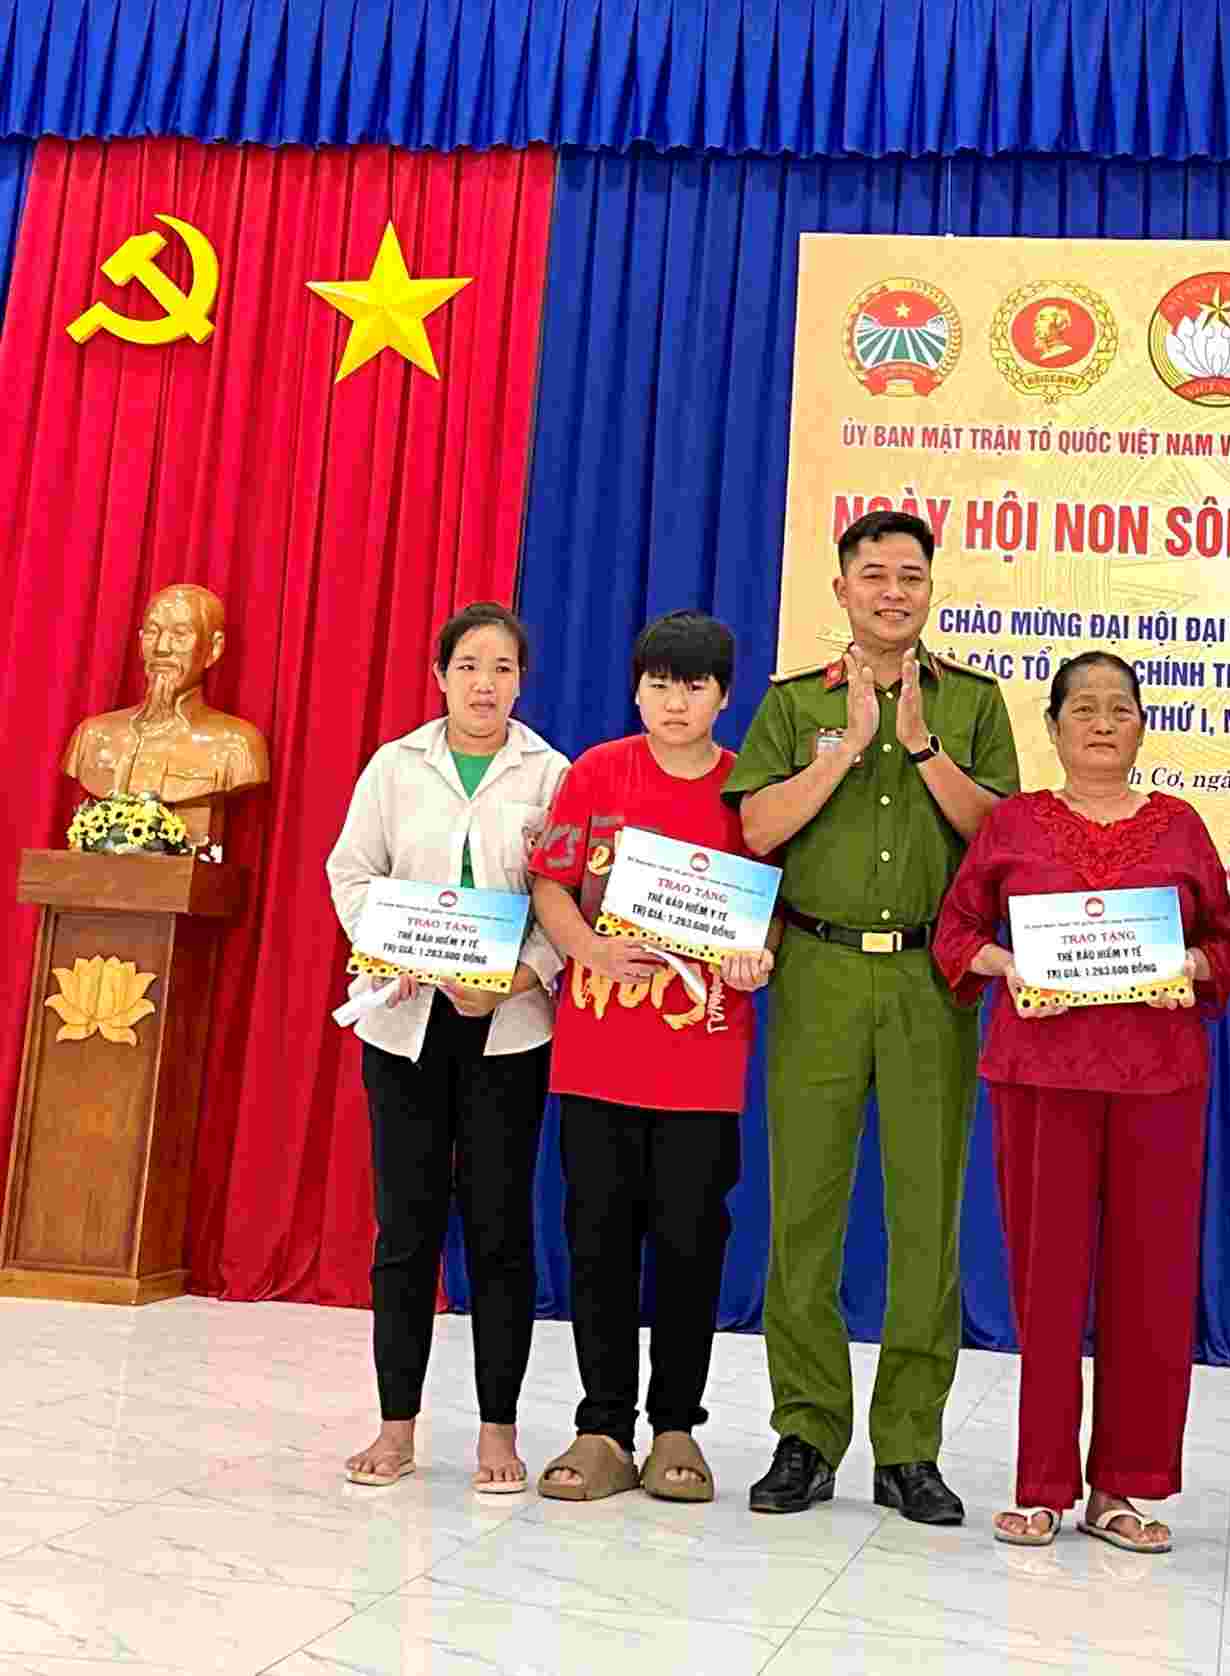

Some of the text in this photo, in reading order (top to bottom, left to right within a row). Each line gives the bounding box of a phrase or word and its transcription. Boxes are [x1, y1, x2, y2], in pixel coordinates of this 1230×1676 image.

[843, 417, 867, 447] ỦY
[874, 426, 914, 448] BAN
[922, 424, 963, 454] MẶT
[970, 424, 1020, 455] TRẬN
[1029, 420, 1052, 451] TỔ
[1058, 424, 1111, 454] QUỐC
[1118, 428, 1160, 459] VIỆT
[1166, 433, 1213, 456] NAM
[965, 490, 1038, 562] HỘI
[1054, 503, 1149, 555] NON
[939, 604, 1002, 633] CHÀO
[1011, 606, 1081, 638] MỪNG
[1089, 614, 1129, 645] ĐẠI
[1138, 611, 1177, 646] HỘI
[1186, 617, 1225, 648] ĐẠI
[1022, 646, 1052, 680] TỔ
[1134, 655, 1204, 688] CHÍNH
[1147, 704, 1194, 733] THỨ
[1152, 767, 1184, 789] Cơ,
[657, 878, 690, 893] TRAO
[1062, 933, 1096, 945] TRAO
